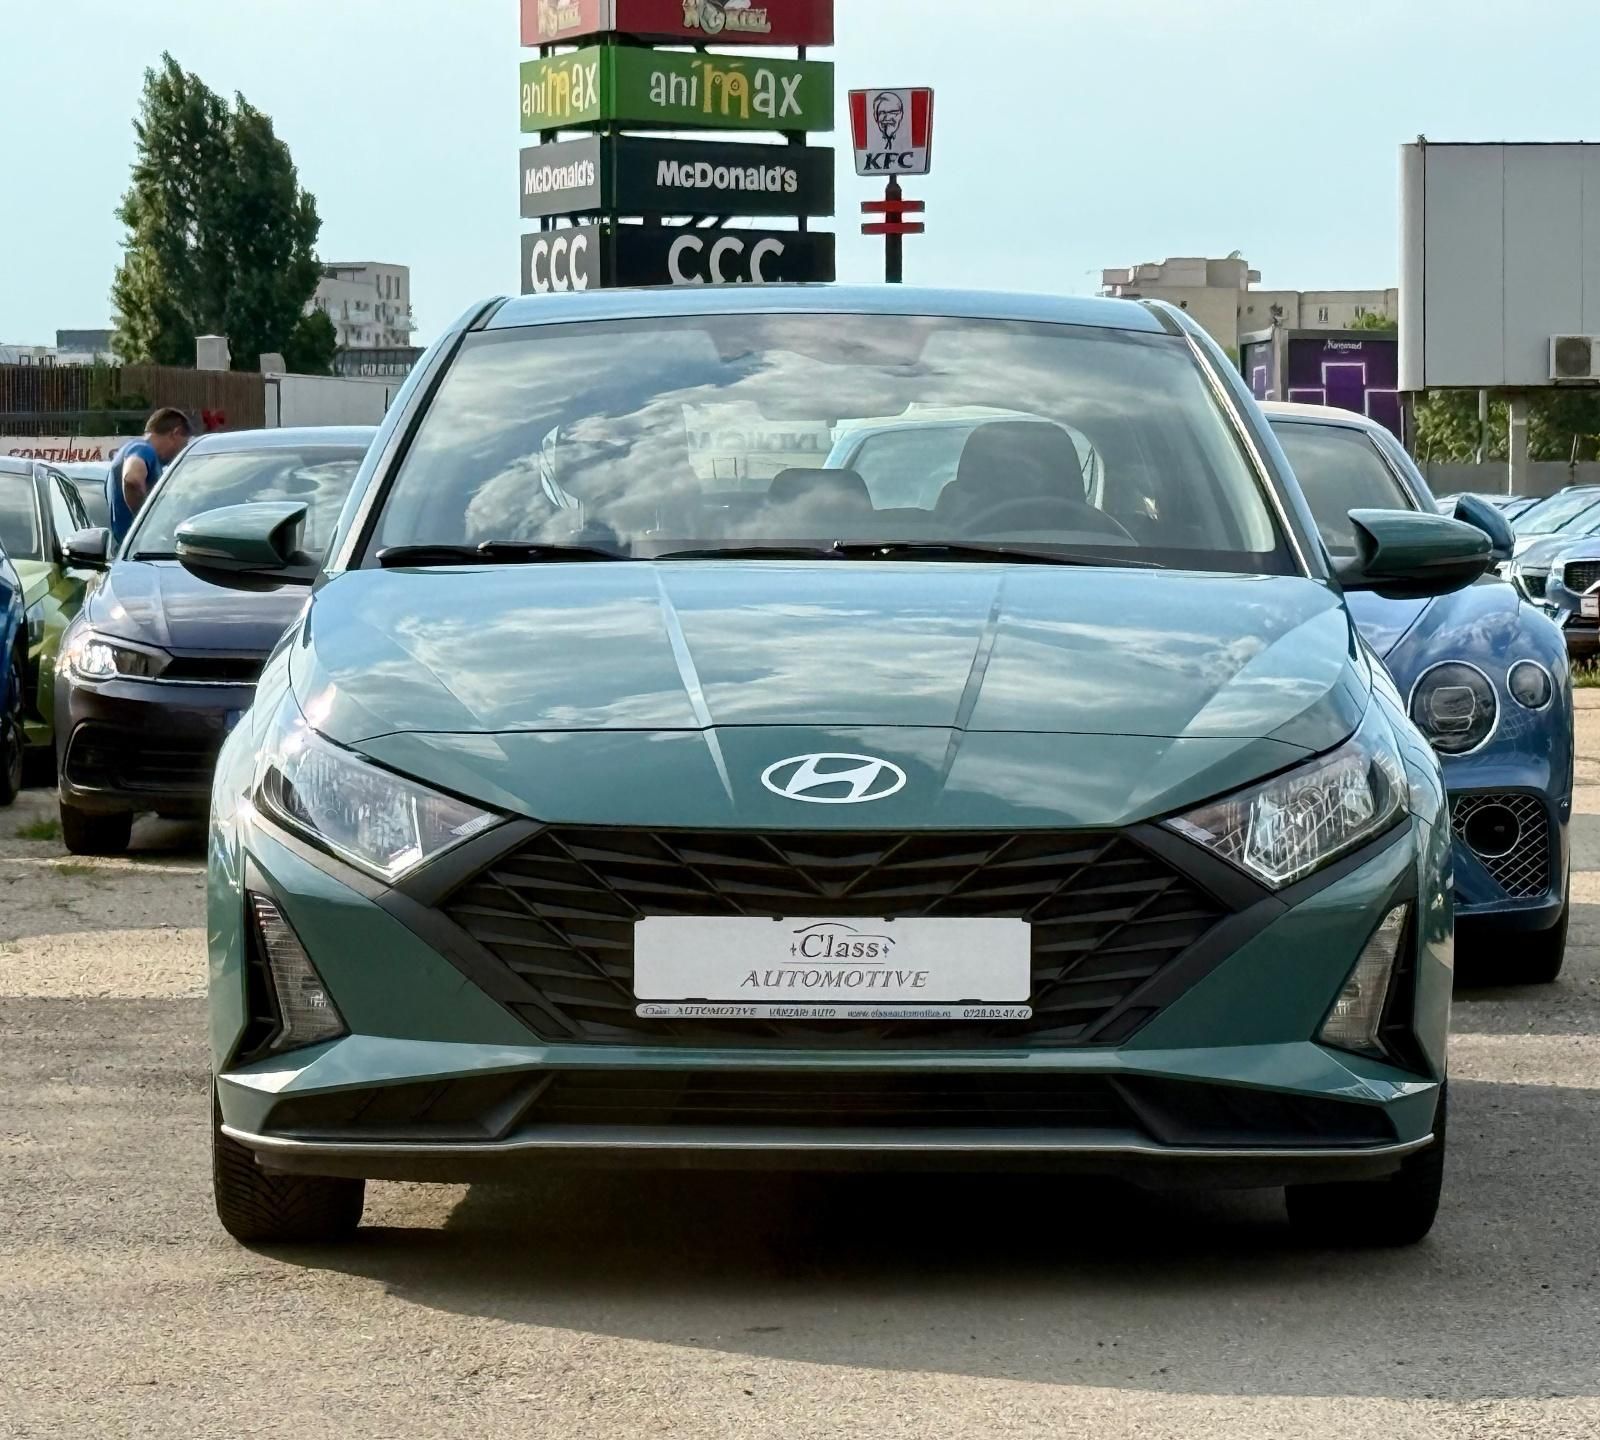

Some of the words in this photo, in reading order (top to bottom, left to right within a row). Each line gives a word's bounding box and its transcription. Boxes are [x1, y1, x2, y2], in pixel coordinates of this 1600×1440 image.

[522, 62, 598, 118] animax
[649, 61, 803, 119] animax
[524, 159, 595, 195] McDonald's
[656, 160, 798, 193] McDonald's
[864, 152, 914, 170] KFC
[531, 234, 588, 291] CCC
[667, 234, 785, 284] CCC
[799, 933, 880, 958] Class
[740, 970, 929, 988] AUTOMOTIVE
[675, 1006, 757, 1016] AUTOMOTIVE
[811, 1008, 836, 1017] AUTO
